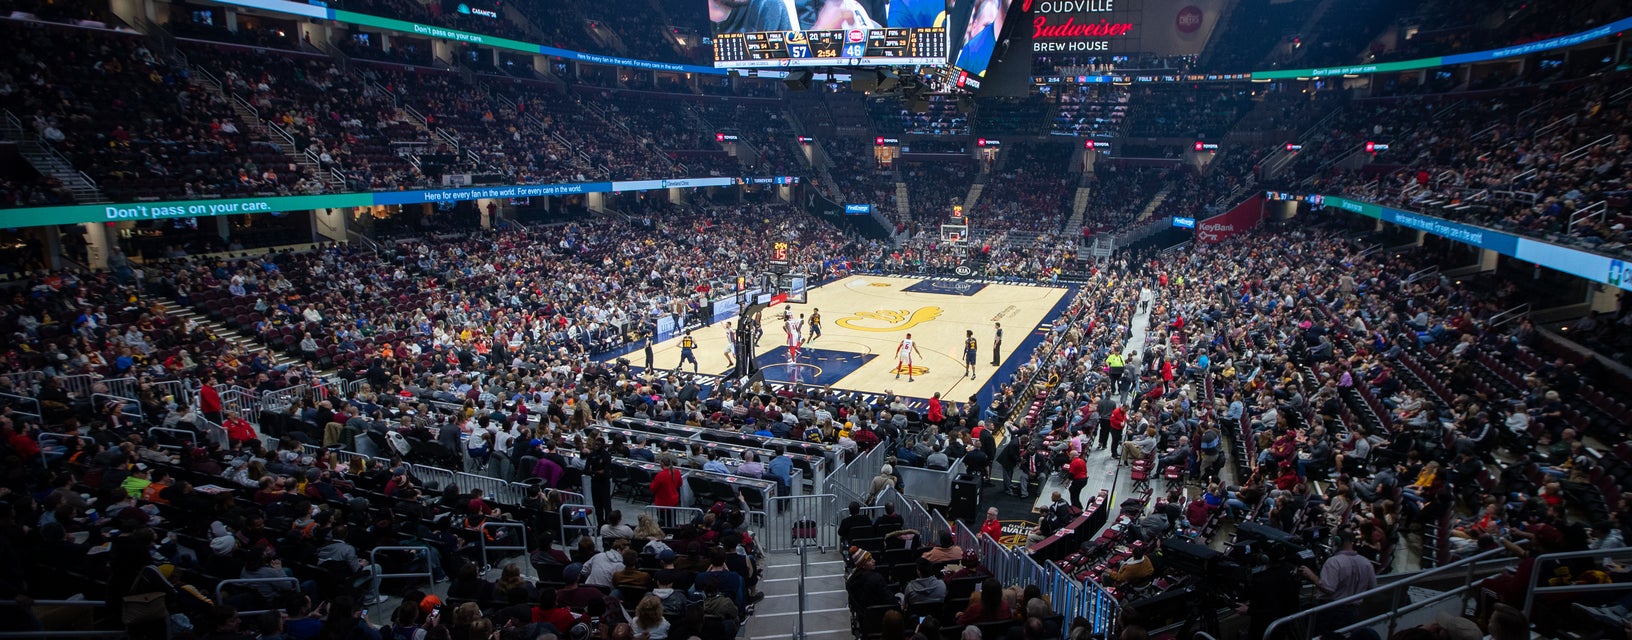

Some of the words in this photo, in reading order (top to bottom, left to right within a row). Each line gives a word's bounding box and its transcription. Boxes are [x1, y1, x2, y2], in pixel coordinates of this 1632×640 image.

[1034, 0, 1113, 13] OUDVILLE
[414, 24, 431, 35] Don't
[432, 29, 446, 37] pass
[456, 33, 469, 41] your
[1032, 15, 1133, 39] Budweiser
[847, 45, 861, 57] 46
[1034, 42, 1065, 51] BREW
[1069, 41, 1108, 51] HOUSE
[793, 47, 806, 58] 57
[817, 50, 836, 58] 2:54
[424, 190, 441, 201] Here
[442, 190, 451, 199] for
[452, 189, 471, 201] every
[471, 188, 481, 198] fan
[482, 188, 488, 197] in
[489, 187, 498, 197] the
[499, 186, 516, 196] world.
[517, 186, 526, 196] For
[527, 186, 542, 198] every
[542, 186, 554, 194] care
[555, 185, 559, 193] in
[560, 184, 568, 193] the
[569, 183, 582, 192] world.
[105, 205, 148, 220] Don't
[151, 205, 185, 219] pass
[189, 203, 206, 214] on
[209, 201, 239, 217] your
[241, 199, 272, 212] care.
[1199, 223, 1233, 232] KeyBank
[777, 250, 785, 260] 15
[1001, 526, 1031, 535] AVALI
